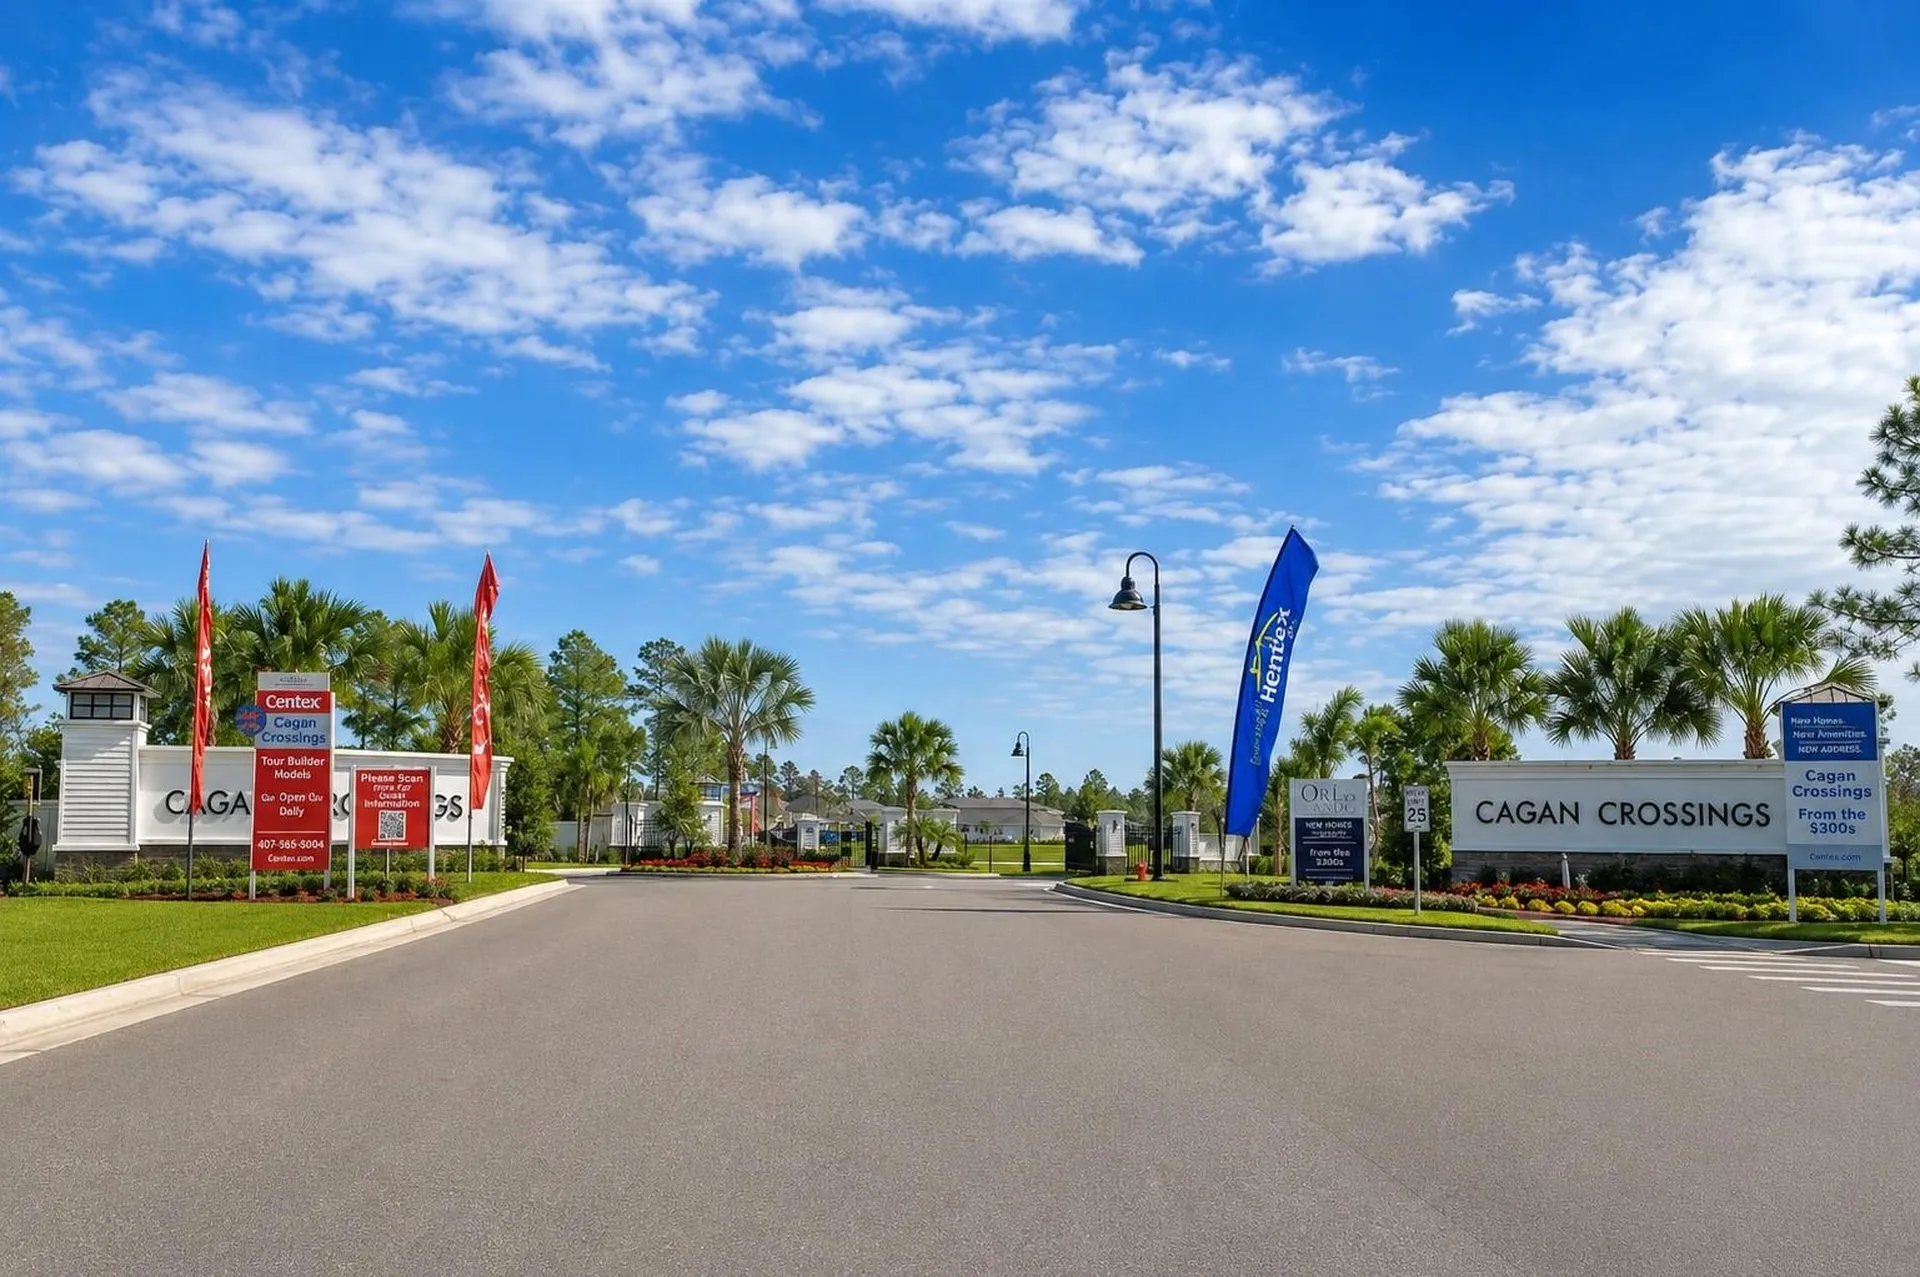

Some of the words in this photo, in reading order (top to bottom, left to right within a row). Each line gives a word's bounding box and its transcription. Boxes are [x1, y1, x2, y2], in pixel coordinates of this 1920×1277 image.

[266, 694, 322, 709] Centex
[274, 717, 317, 730] Cagan
[261, 731, 326, 746] Crossings
[261, 756, 285, 766] Tour
[287, 756, 325, 766] Builder
[274, 769, 312, 780] Models
[361, 773, 395, 783] Please
[398, 773, 423, 783] Scan
[1805, 769, 1856, 784] Cagan
[1792, 784, 1872, 800] Crossings
[279, 806, 305, 818] Daily
[1407, 807, 1426, 822] 25
[1475, 800, 1580, 825] CAGAN
[1598, 801, 1771, 828] CROSSINGS
[1798, 808, 1837, 820] From
[1841, 808, 1866, 820] the
[1810, 821, 1856, 835] $300s
